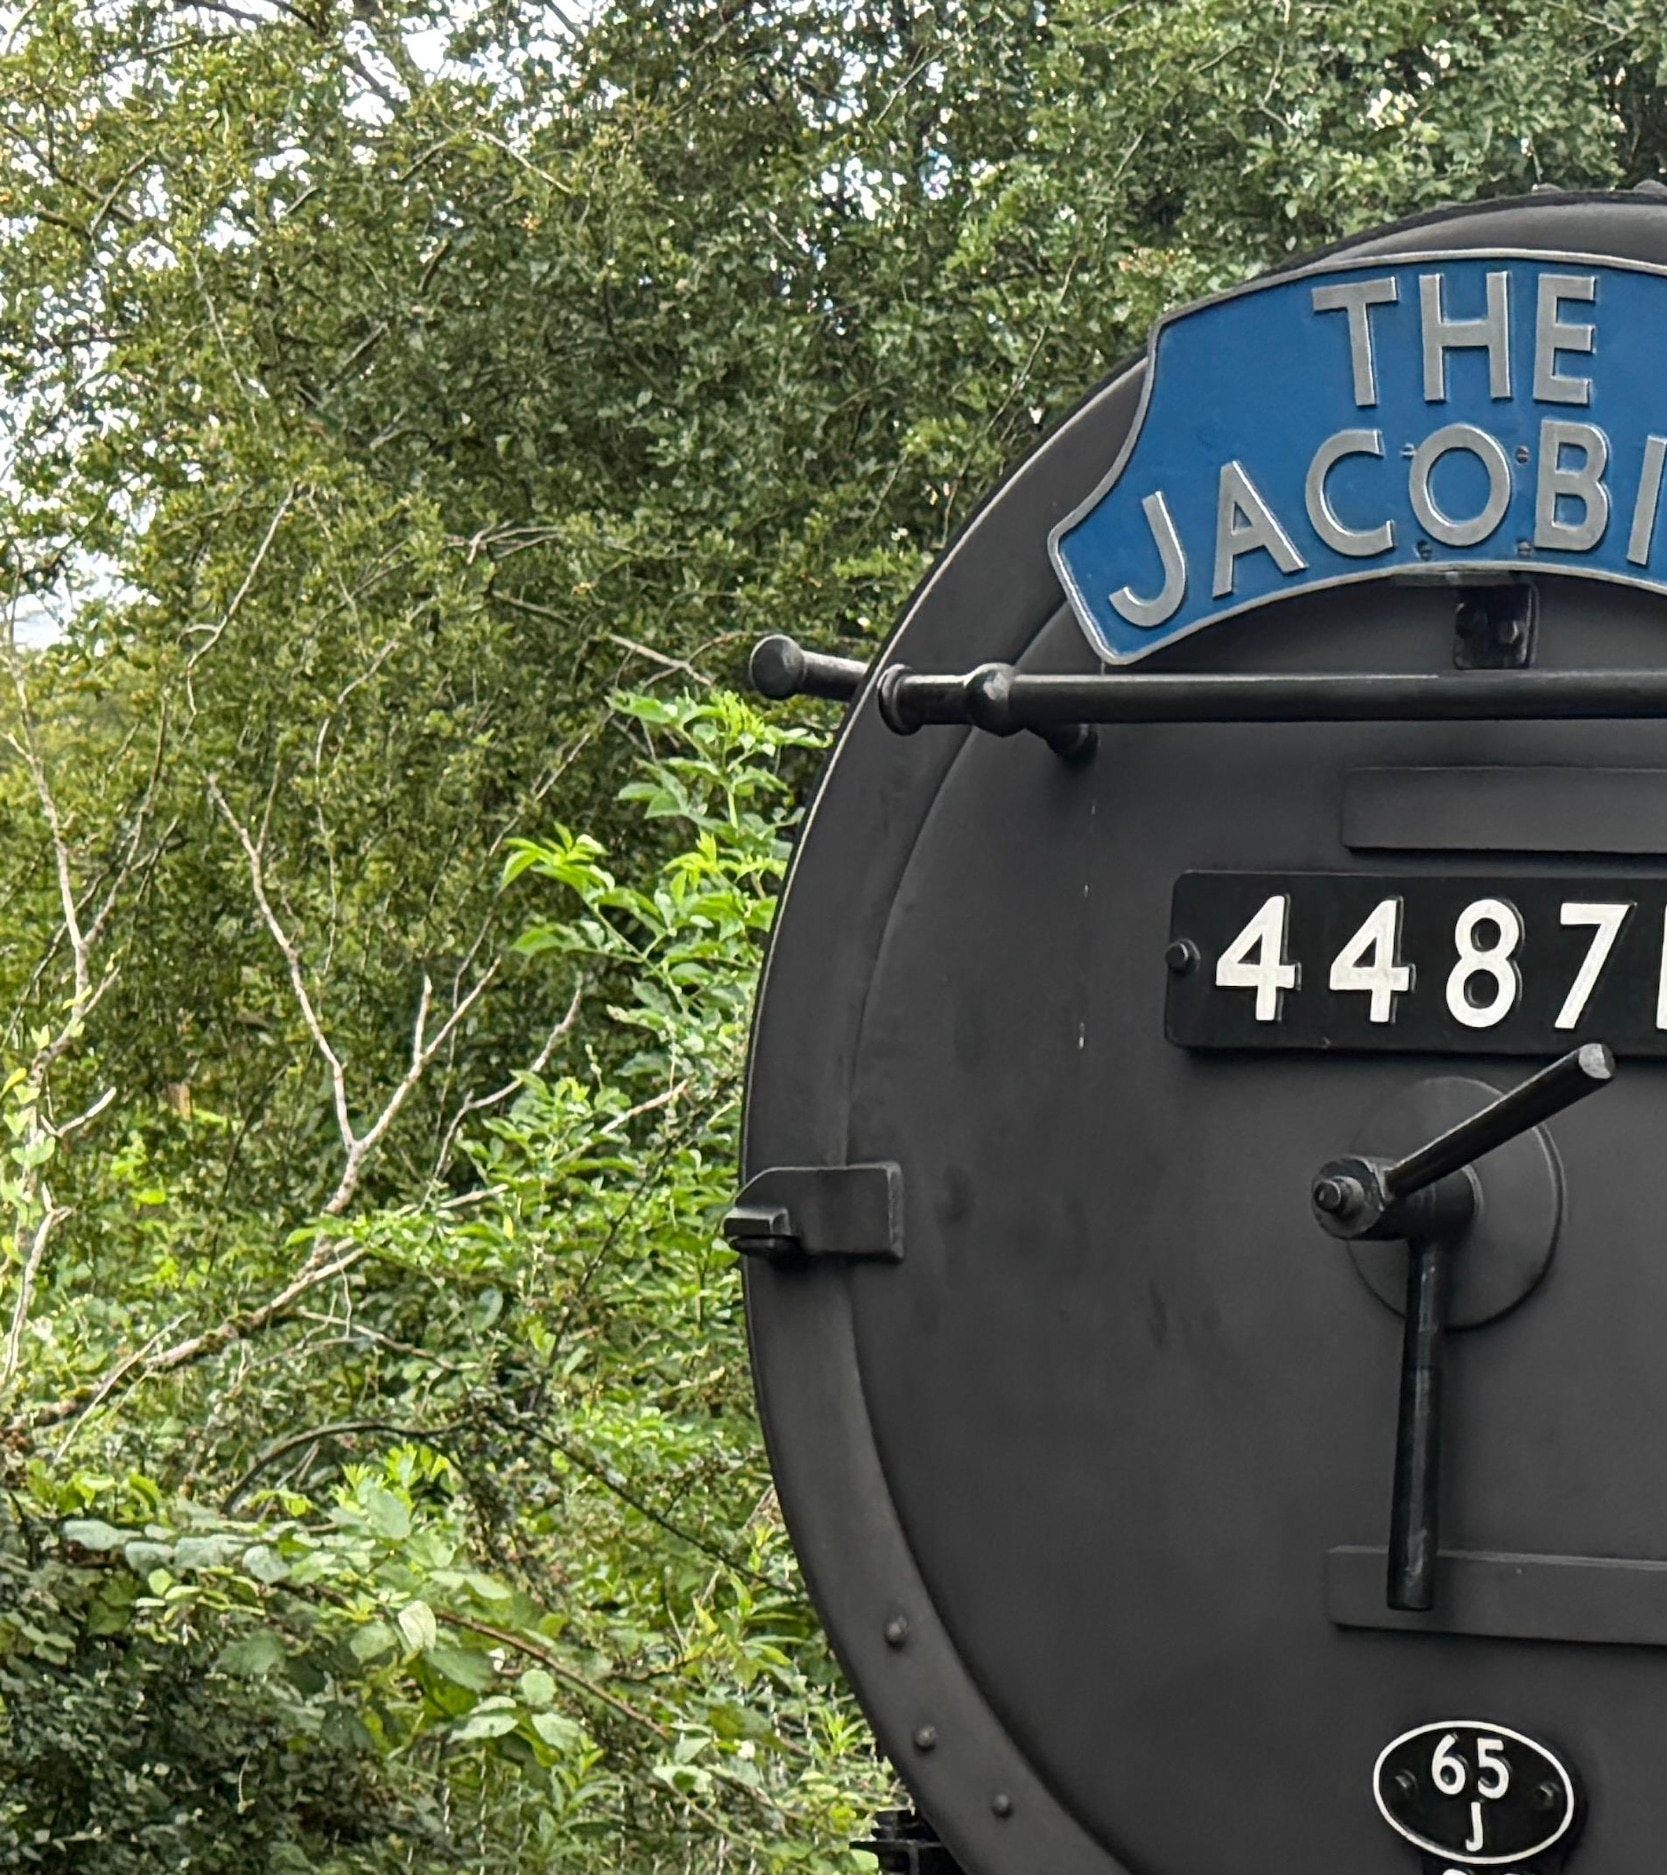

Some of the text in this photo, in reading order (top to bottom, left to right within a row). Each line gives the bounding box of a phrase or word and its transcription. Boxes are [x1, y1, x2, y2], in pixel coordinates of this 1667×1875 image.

[1311, 270, 1598, 408] THE
[1431, 1732, 1512, 1800] 65
[1465, 1801, 1484, 1852] J
